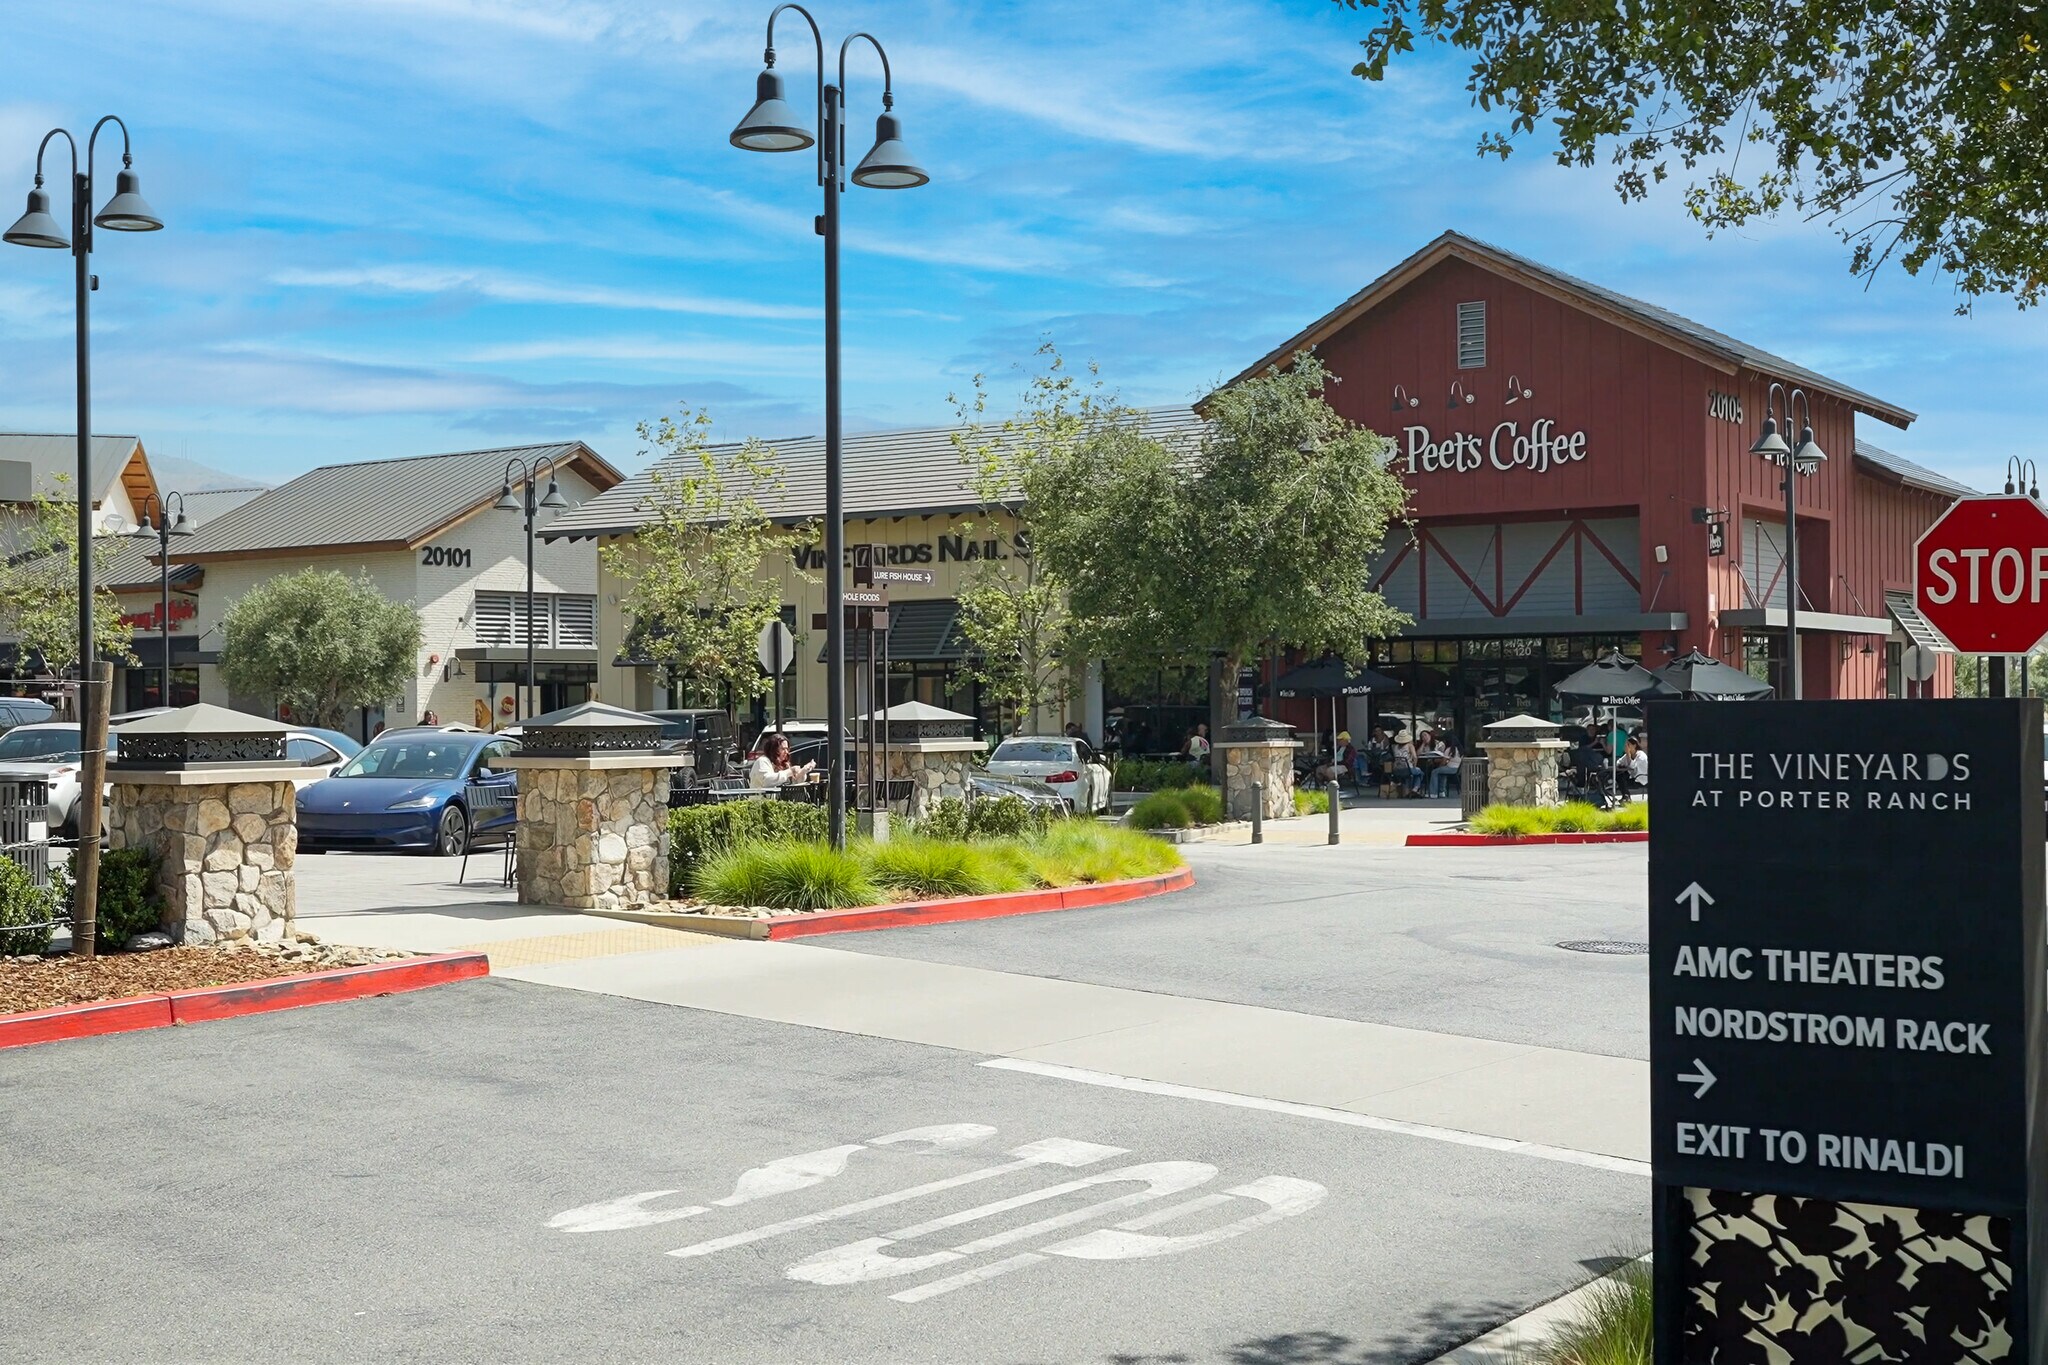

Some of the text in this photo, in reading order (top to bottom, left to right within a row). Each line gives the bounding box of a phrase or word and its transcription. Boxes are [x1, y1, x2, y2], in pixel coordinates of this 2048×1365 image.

[1708, 389, 1744, 425] 20105
[1403, 418, 1587, 474] Peet's Coffee
[422, 546, 472, 568] 20101
[889, 572, 902, 580] FISH
[903, 573, 922, 582] HOUSE
[842, 592, 880, 601] HOLE FOODS
[1691, 753, 1970, 782] THE VINEYARDS
[1692, 790, 1971, 811] AT PORTER RANCH
[1673, 945, 1945, 990] AMC THEATERS
[1675, 1006, 1992, 1055] NORDSTROM RACK
[1676, 1122, 1964, 1178] EXIT TO RINALDI
[543, 1122, 1329, 1303] STOP
